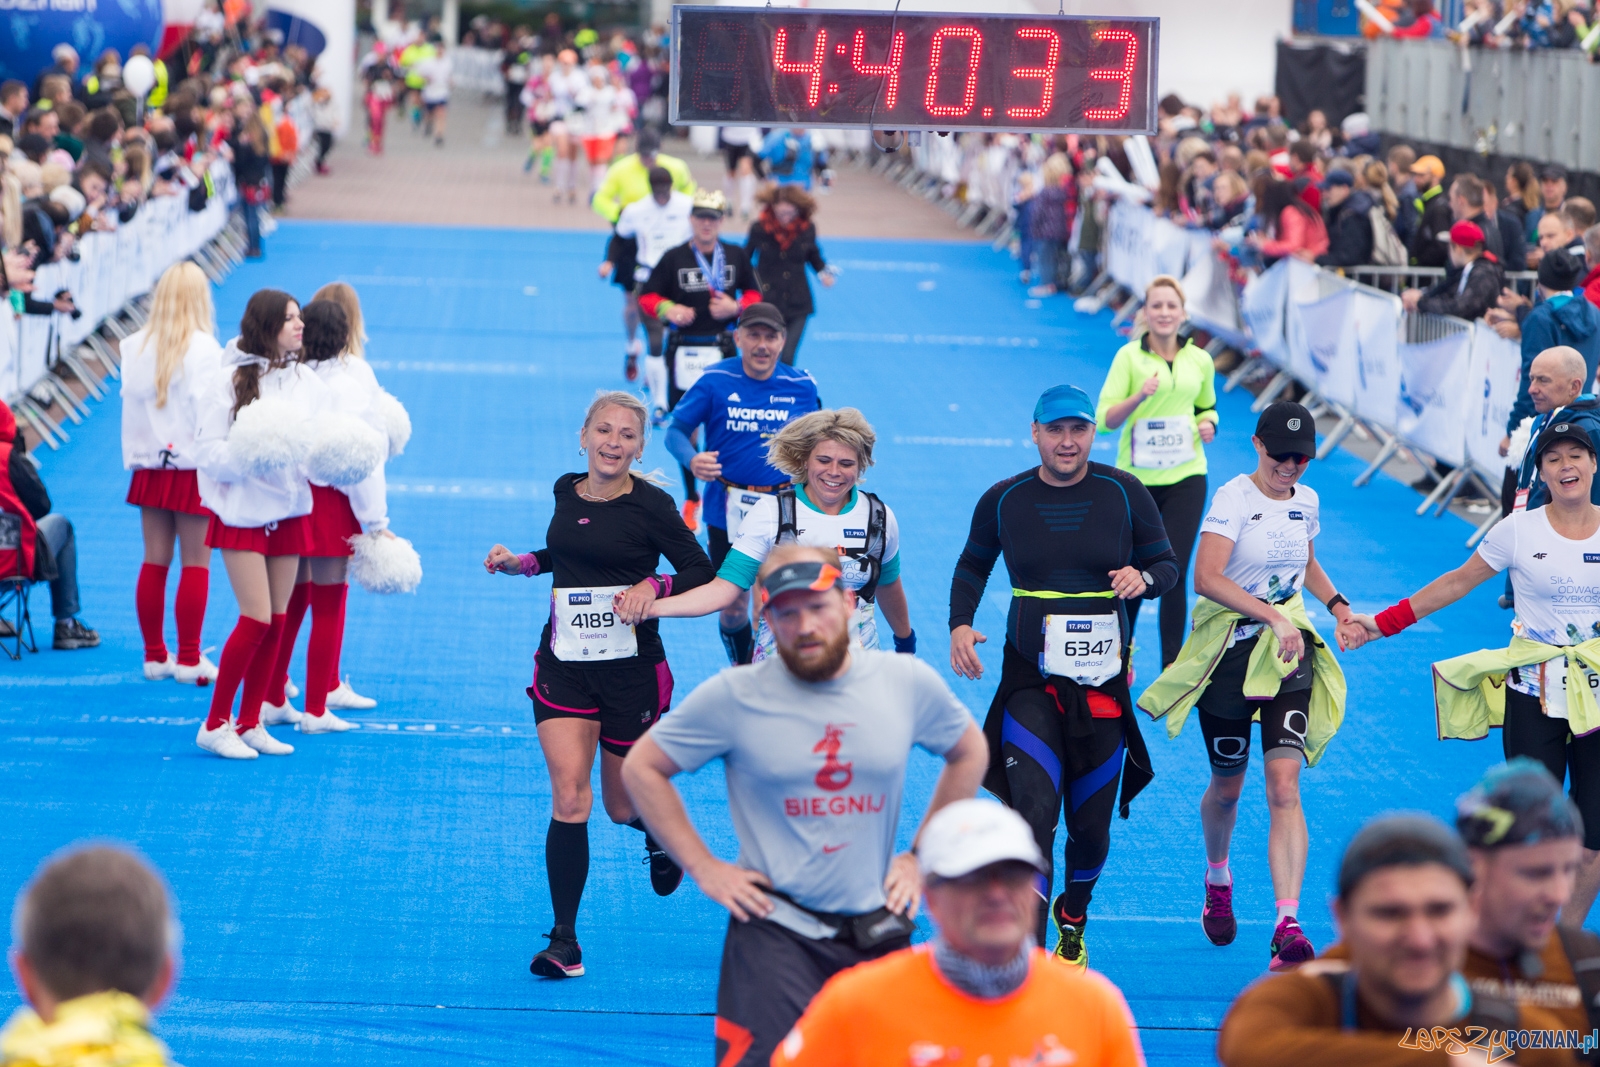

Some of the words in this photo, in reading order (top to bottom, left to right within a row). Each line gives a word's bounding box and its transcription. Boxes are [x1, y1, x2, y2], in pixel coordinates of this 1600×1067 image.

[774, 26, 1137, 119] 4:40.33
[727, 406, 789, 421] warsaw
[726, 419, 758, 432] runs
[1146, 434, 1184, 446] 4303
[1558, 585, 1600, 594] ODWAG
[571, 612, 614, 628] 4189
[1065, 639, 1113, 656] 6347
[784, 794, 887, 817] BIEGNIJ
